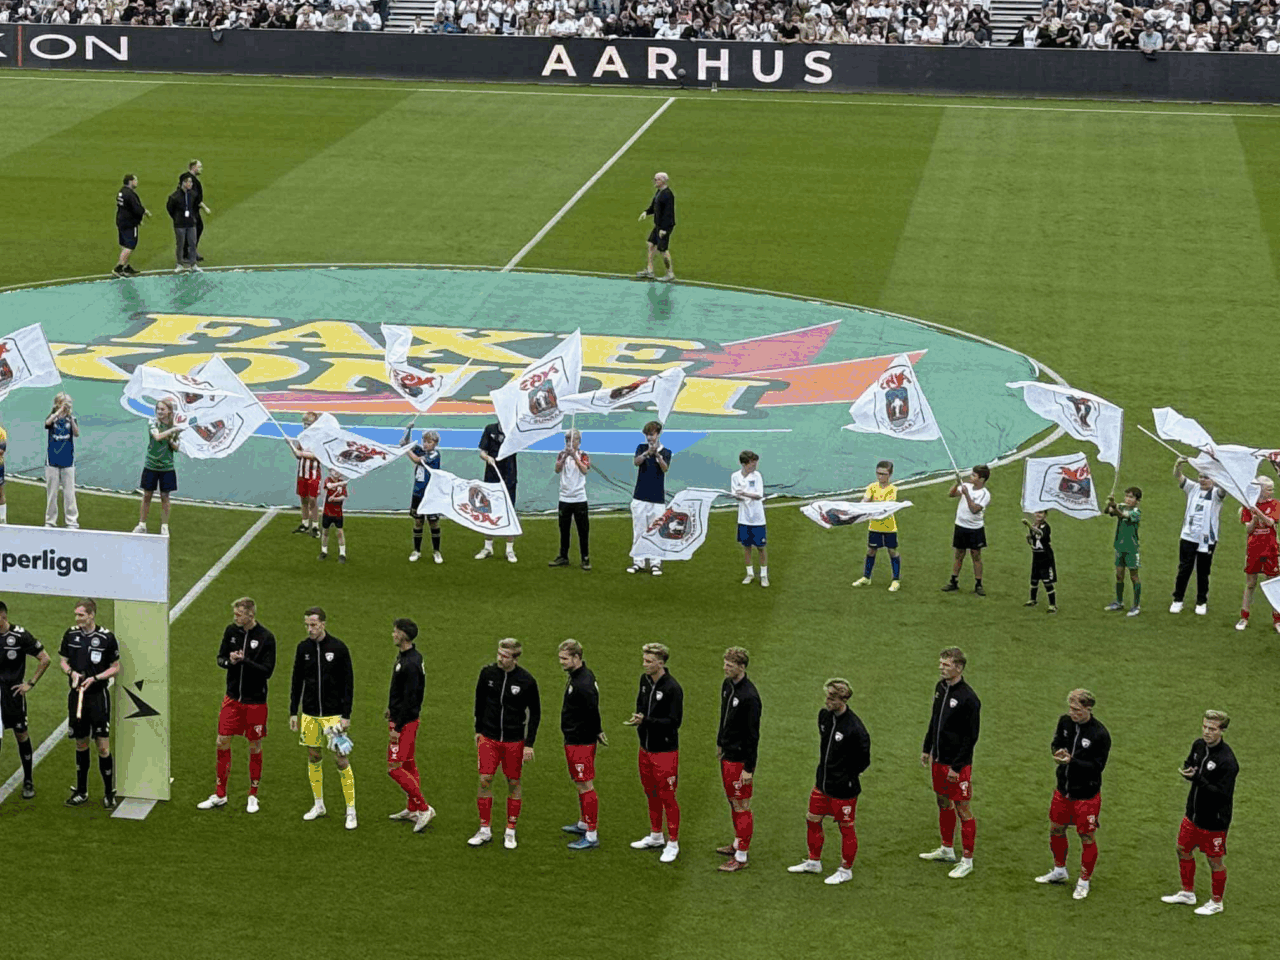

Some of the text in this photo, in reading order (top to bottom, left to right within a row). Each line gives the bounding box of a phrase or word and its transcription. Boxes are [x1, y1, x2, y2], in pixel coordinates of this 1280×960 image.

[29, 33, 128, 61] ON
[541, 44, 833, 84] AARHUS
[109, 312, 707, 373] FAXE
